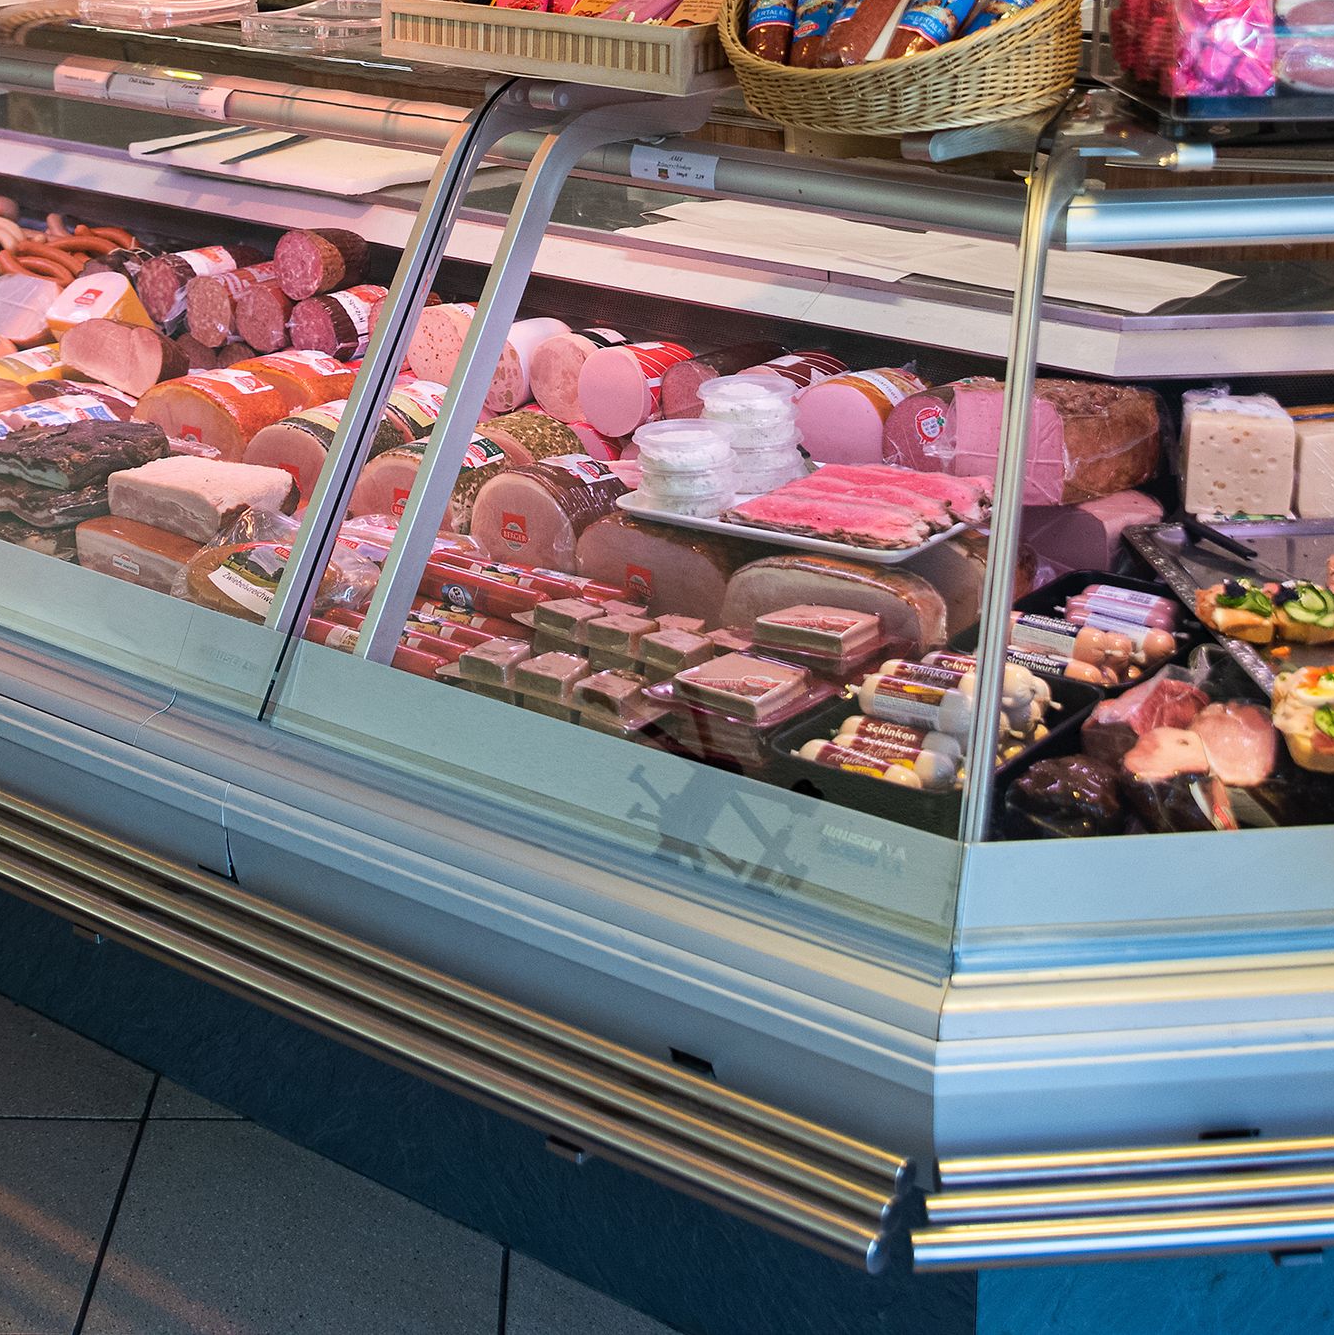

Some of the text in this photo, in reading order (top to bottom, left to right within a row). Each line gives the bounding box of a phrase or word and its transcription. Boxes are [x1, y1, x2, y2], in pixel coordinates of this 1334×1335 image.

[502, 529, 529, 544] BERGER
[1023, 615, 1077, 633] Streichwurst
[904, 665, 955, 680] Schinken
[941, 659, 976, 674] Schink
[1007, 656, 1062, 675] Streichwurst
[865, 722, 916, 741] Schinken
[861, 737, 914, 753] Schinken
